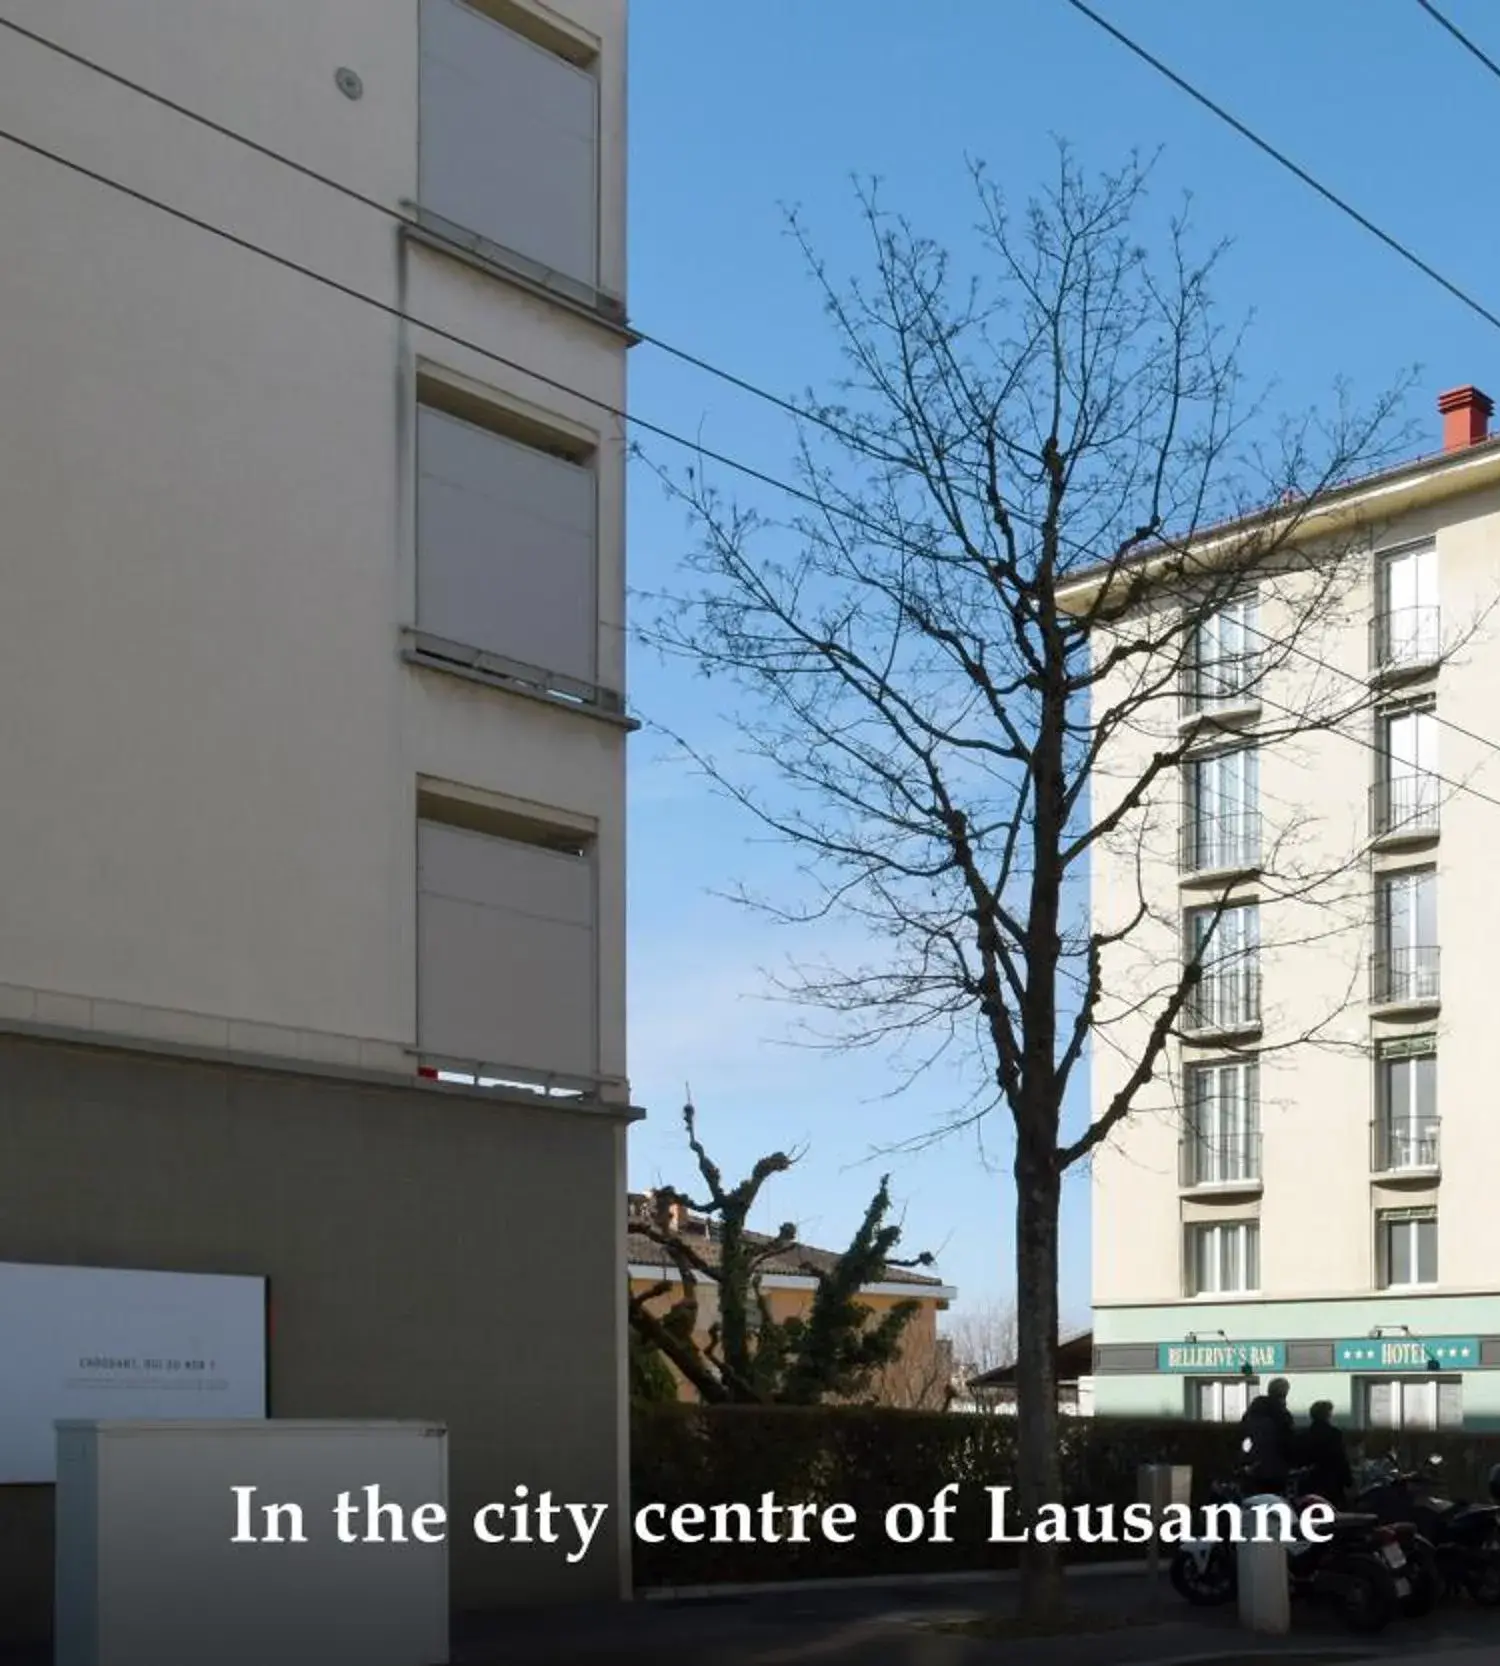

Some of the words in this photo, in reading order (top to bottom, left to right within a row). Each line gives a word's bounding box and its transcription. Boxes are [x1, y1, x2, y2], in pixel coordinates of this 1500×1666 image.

[1168, 1345, 1248, 1367] BELLERIVE'S
[1250, 1344, 1276, 1366] BAR
[1380, 1343, 1428, 1365] HOTEL
